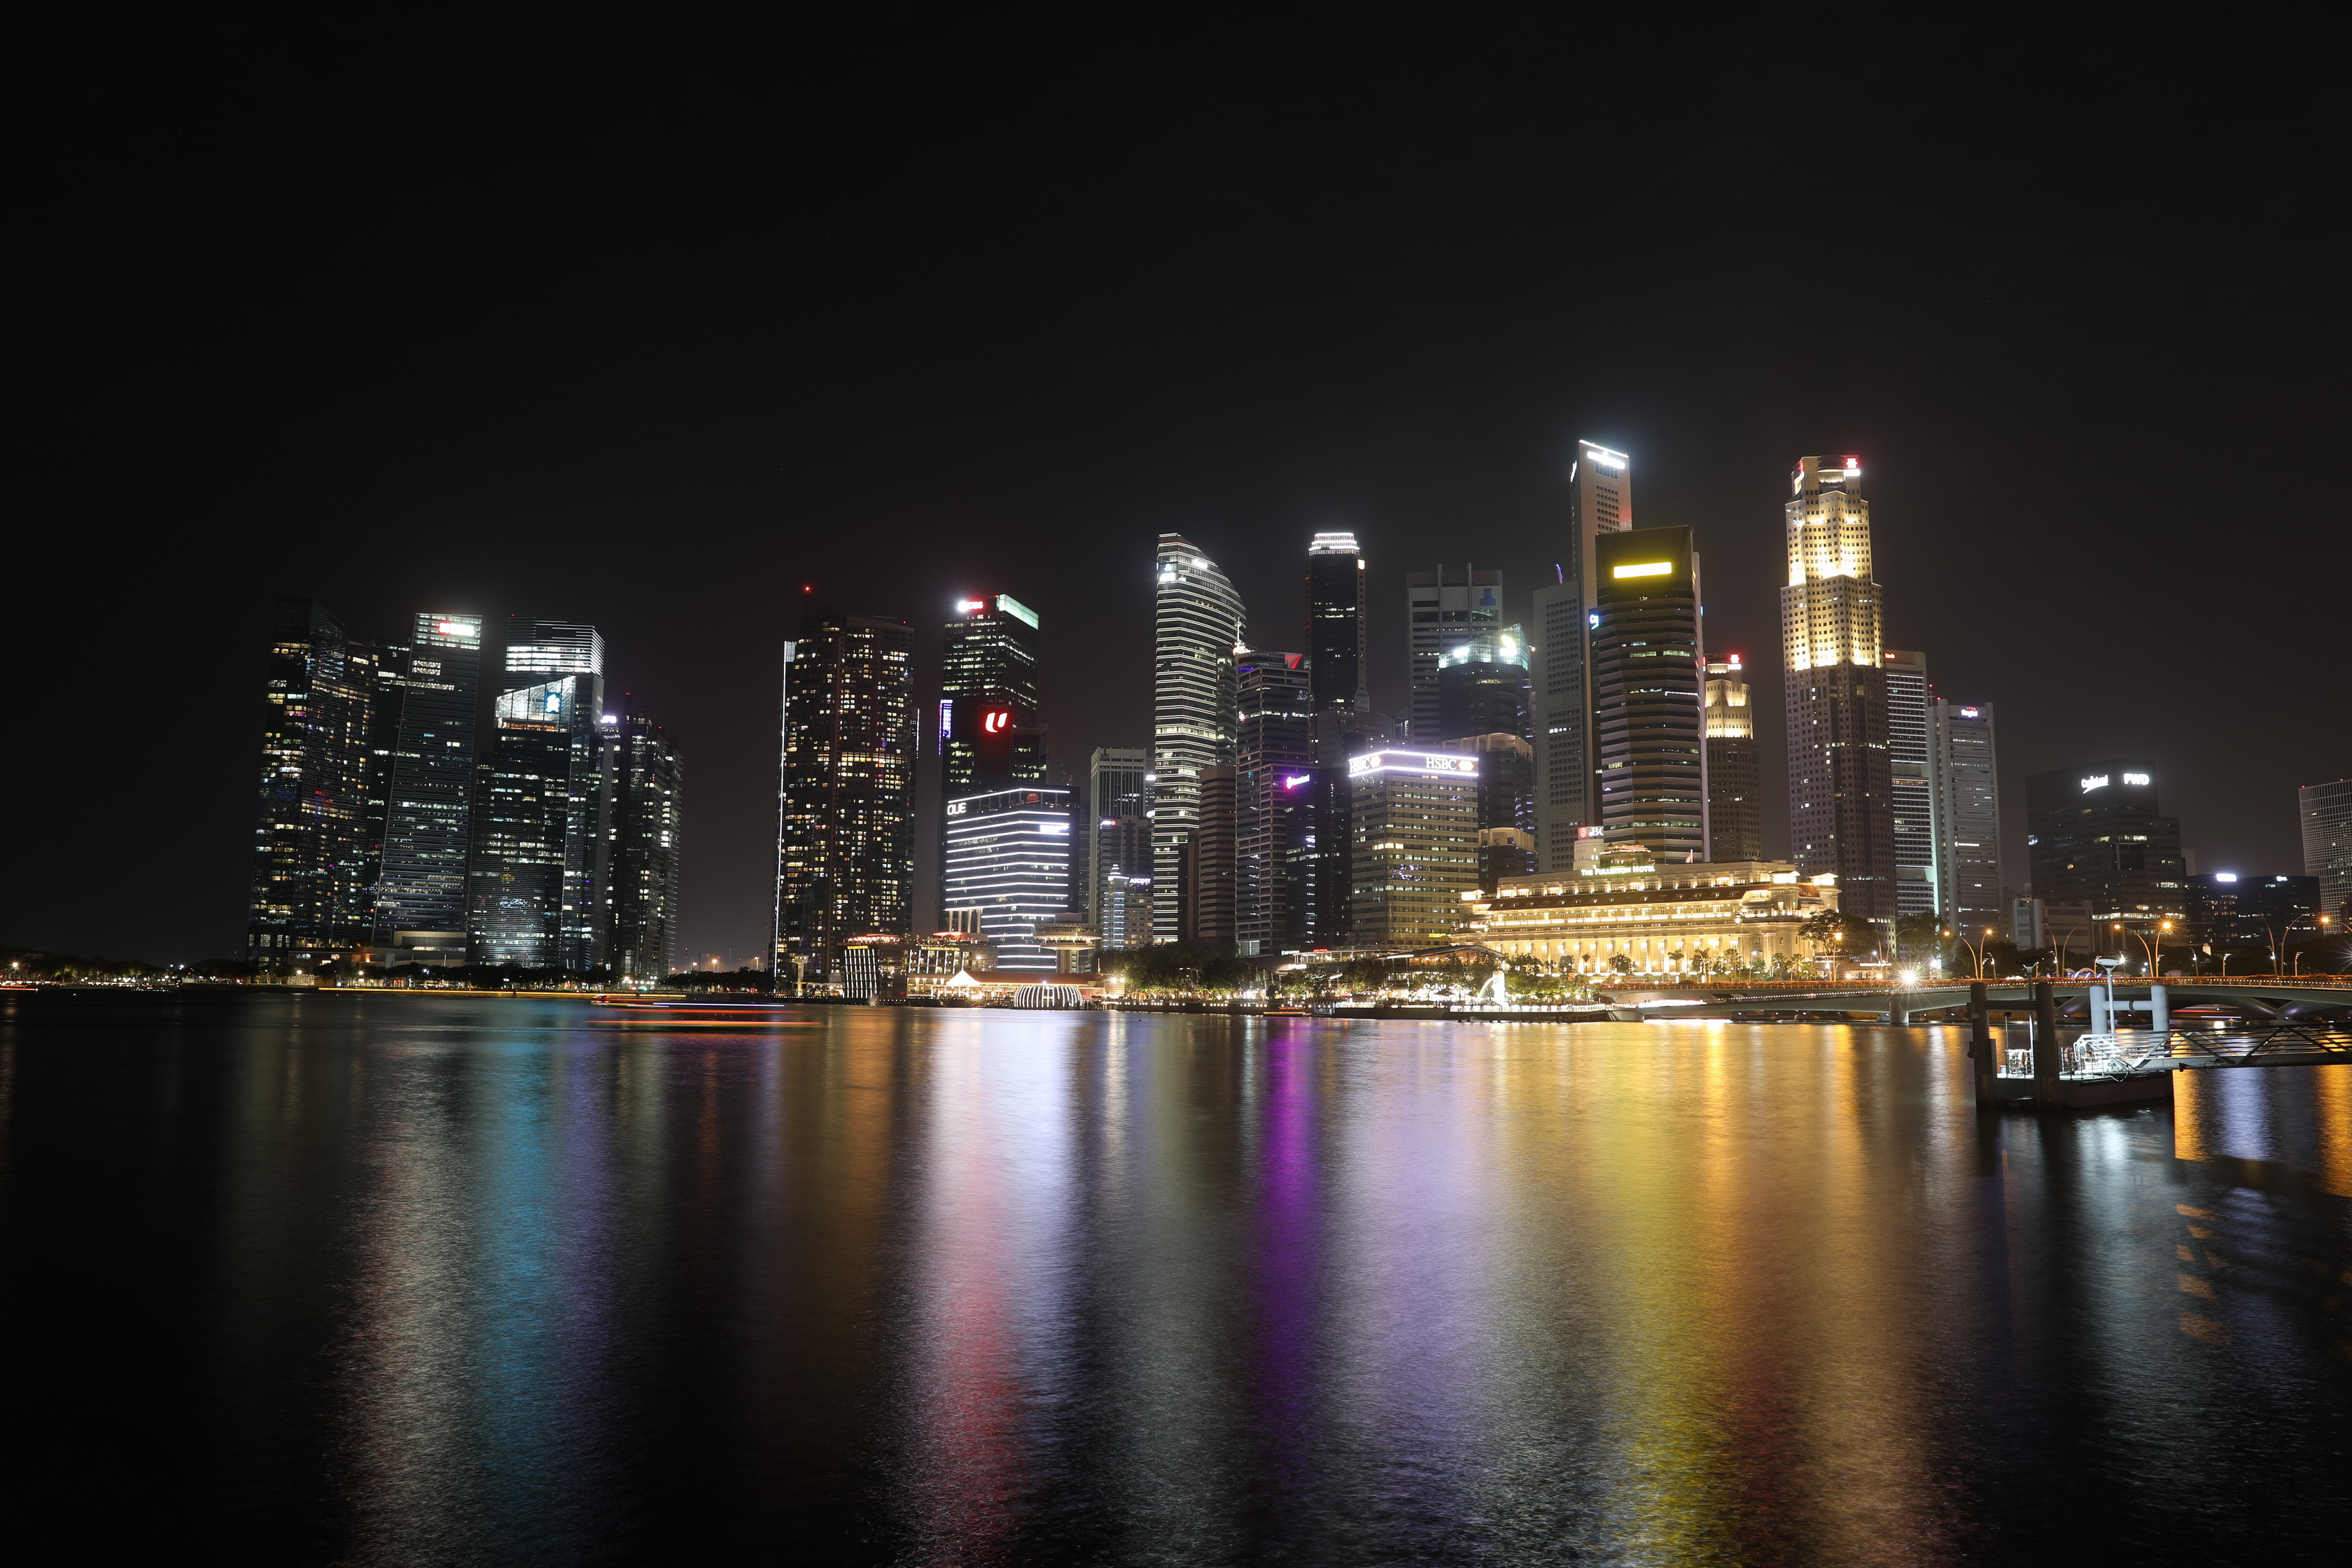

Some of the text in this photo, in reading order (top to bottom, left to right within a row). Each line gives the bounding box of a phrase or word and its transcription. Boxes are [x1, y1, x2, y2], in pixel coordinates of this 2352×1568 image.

[1349, 757, 1371, 774] HSBC
[1425, 756, 1457, 771] HSBC
[2123, 773, 2150, 785] FWD
[947, 802, 967, 816] OUE
[1595, 867, 1632, 876] FULLERTON
